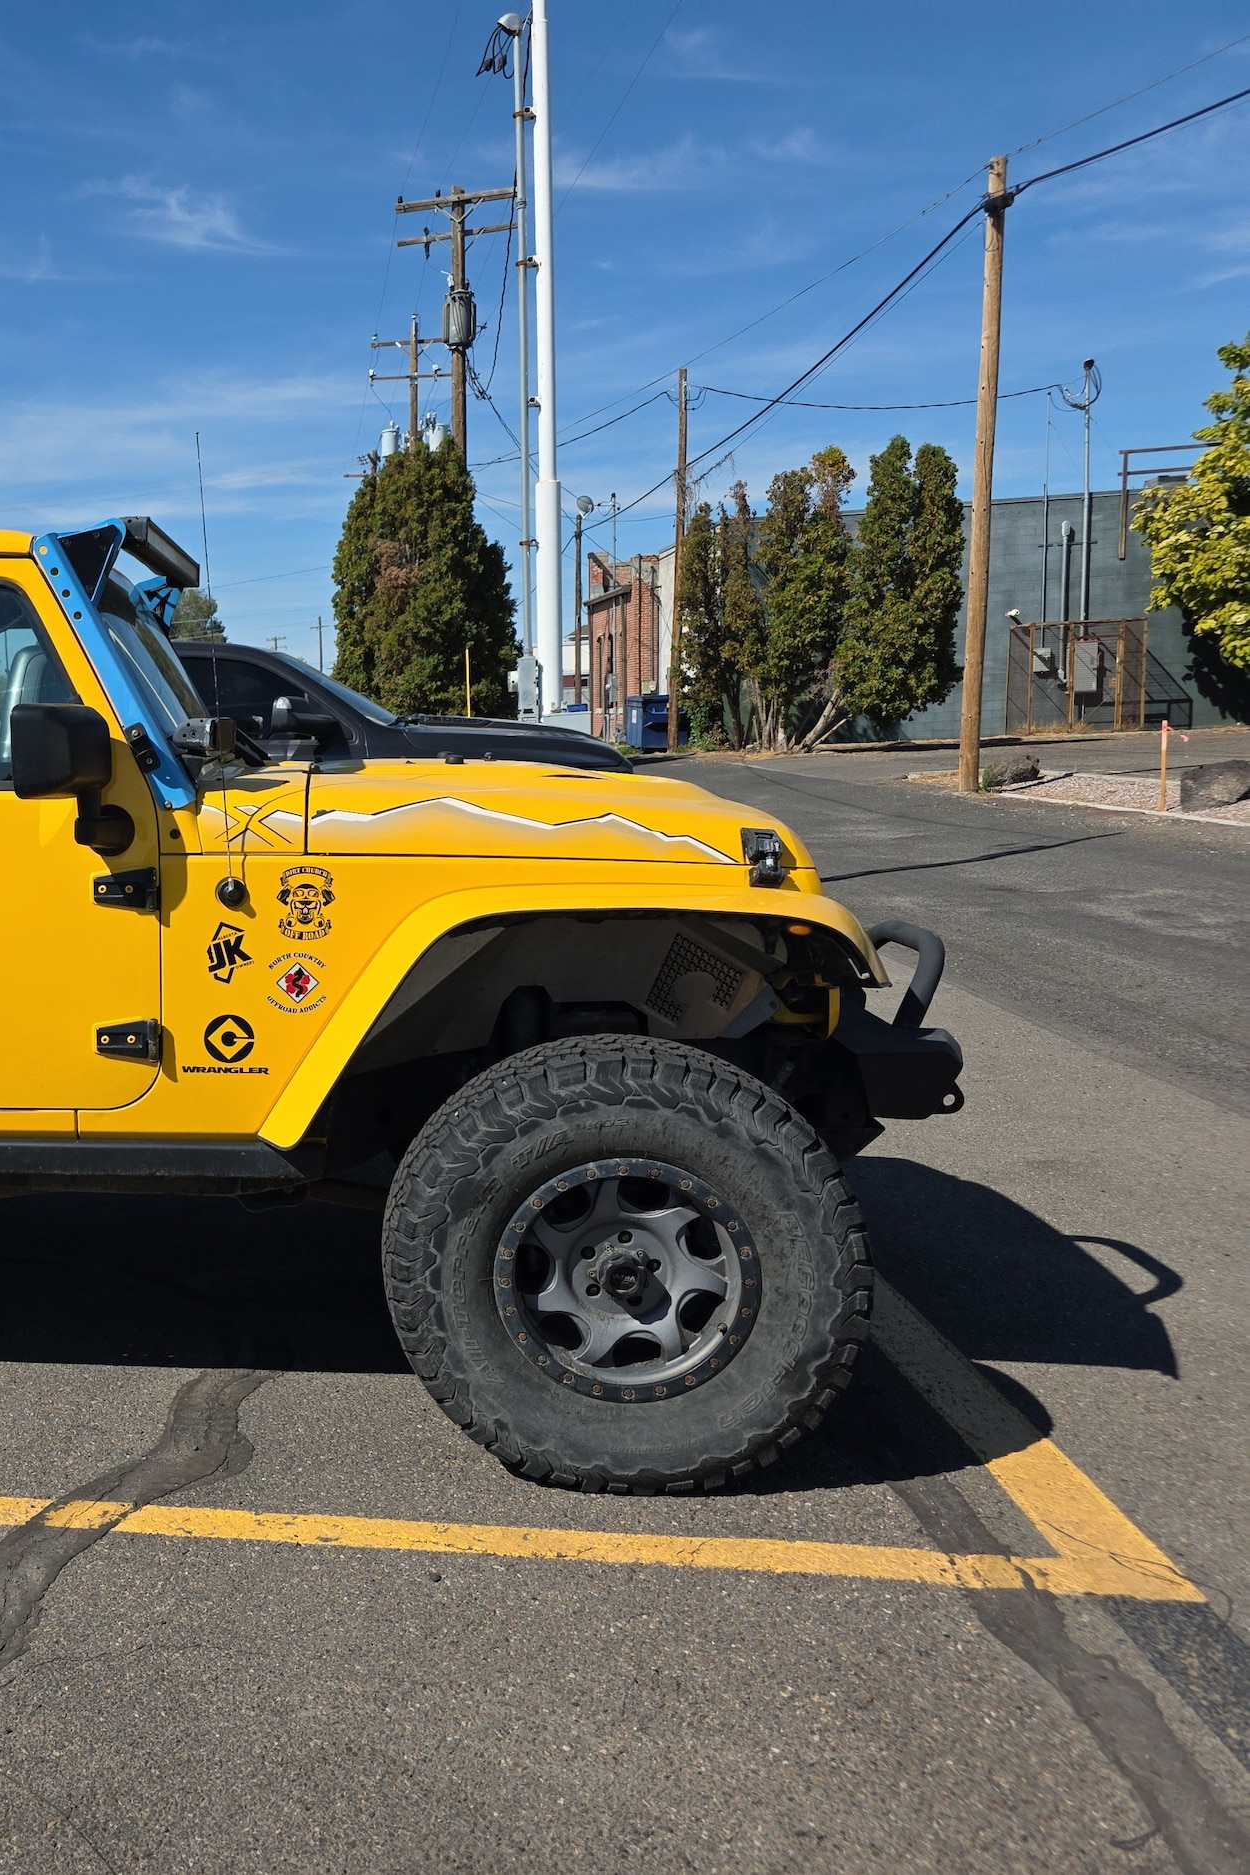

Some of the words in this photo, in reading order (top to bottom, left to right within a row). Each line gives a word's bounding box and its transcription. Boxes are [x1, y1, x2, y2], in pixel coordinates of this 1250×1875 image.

[285, 929, 301, 939] OFF
[302, 929, 325, 940] ROAD
[268, 952, 292, 970] NORTH
[293, 952, 326, 969] COUNTRY
[267, 995, 298, 1014] OFFROAD
[299, 995, 327, 1014] ADDICTS
[181, 1065, 269, 1075] WRANGLER
